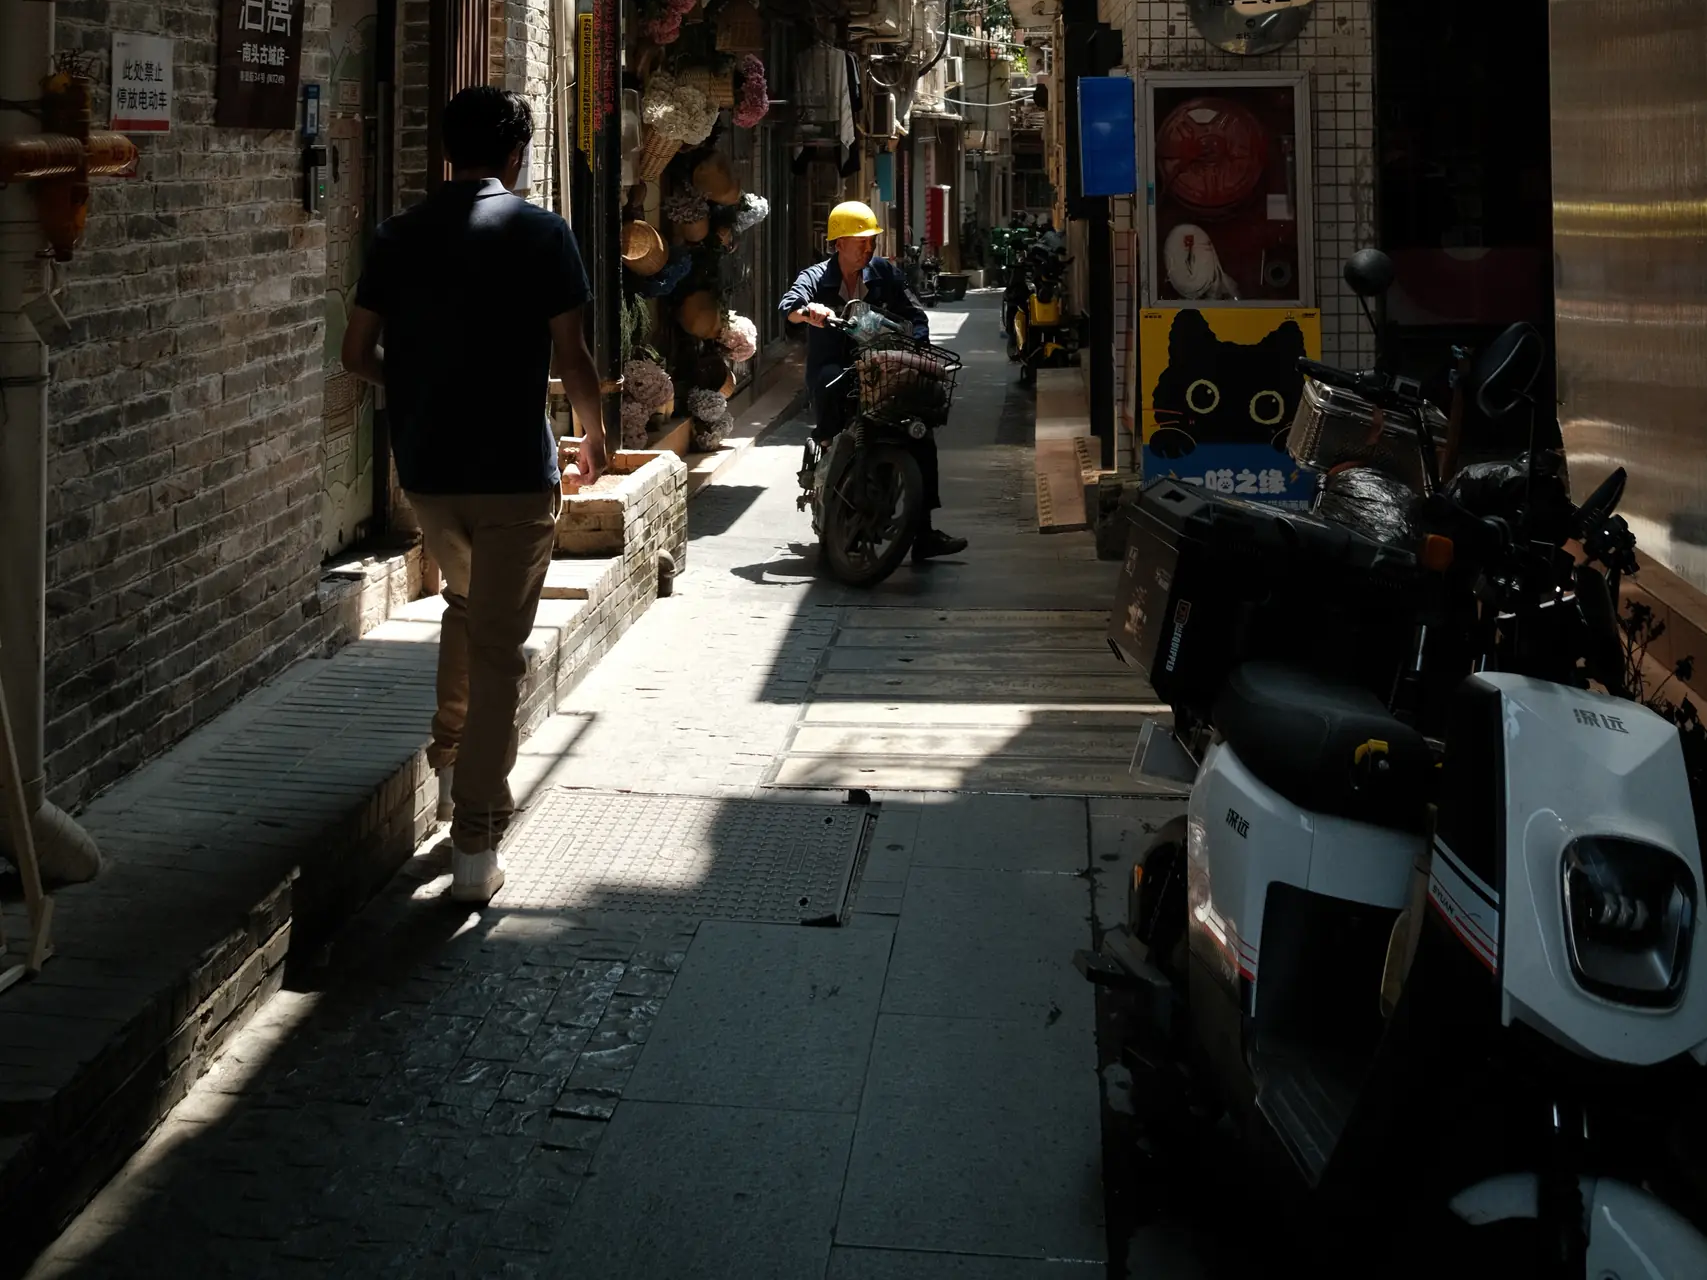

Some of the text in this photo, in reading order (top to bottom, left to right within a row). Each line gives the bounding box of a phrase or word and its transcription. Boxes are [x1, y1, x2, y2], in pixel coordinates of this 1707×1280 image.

[122, 58, 163, 82] 此处禁止
[117, 86, 167, 112] 停放电动车
[1573, 708, 1629, 734] 深远
[1226, 808, 1250, 839] 深远
[1432, 885, 1454, 914] SYUAN
